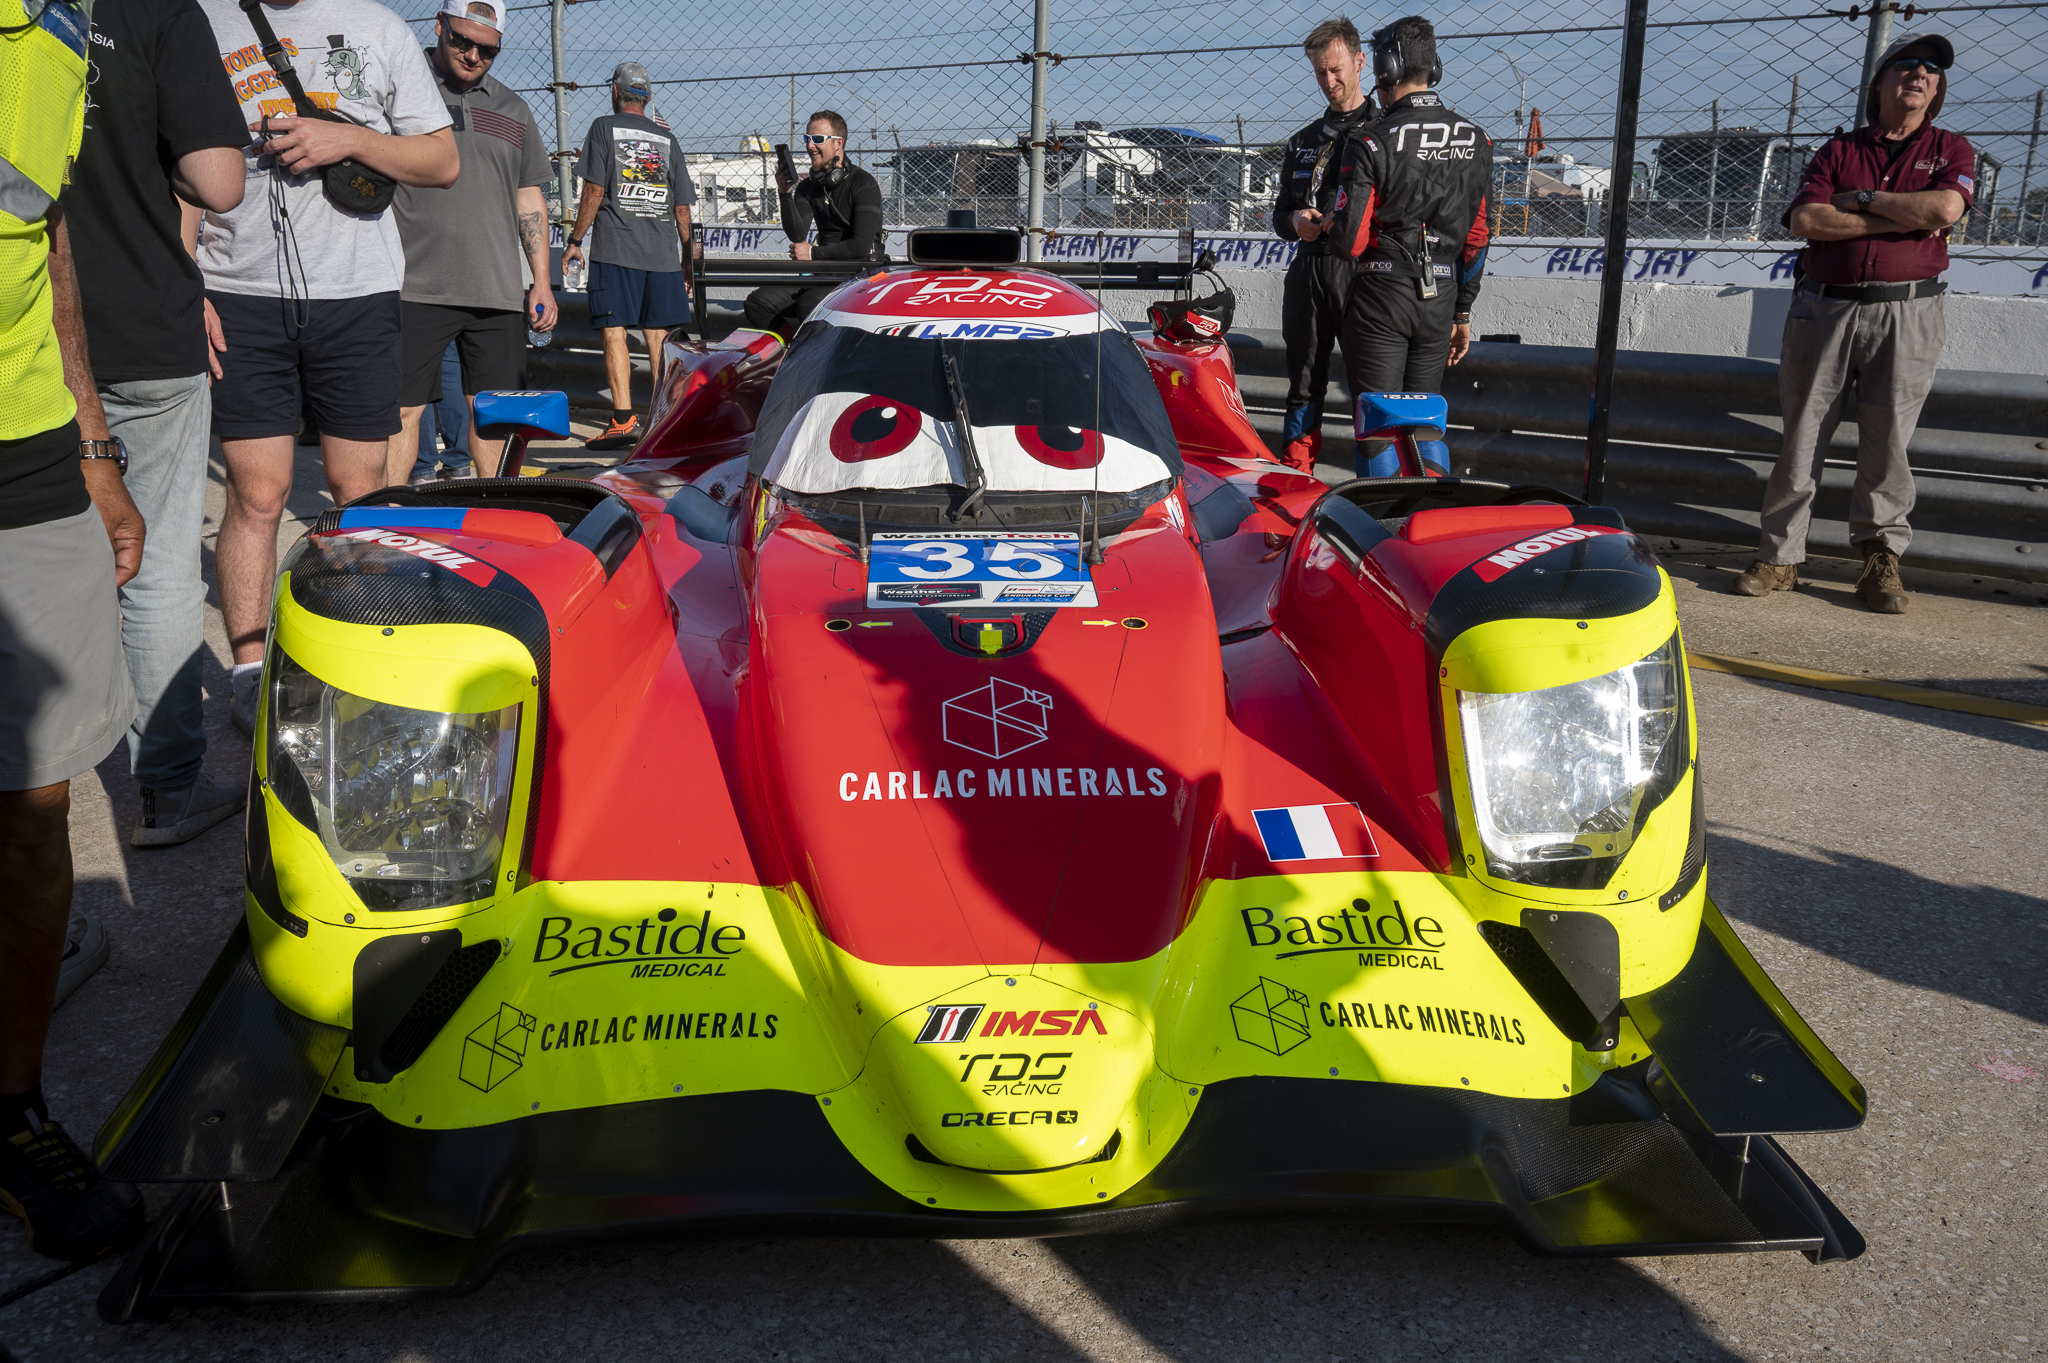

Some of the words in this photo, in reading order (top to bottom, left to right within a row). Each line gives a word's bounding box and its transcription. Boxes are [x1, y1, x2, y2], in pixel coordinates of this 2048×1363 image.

[1389, 121, 1476, 152] TDS
[1416, 147, 1476, 161] RACING
[635, 187, 665, 199] GTP
[1042, 236, 1100, 260] ALAN
[1101, 237, 1143, 262] JAY
[867, 276, 1062, 306] TDS
[904, 293, 1047, 310] RACING
[918, 323, 1055, 340] LMP2
[344, 528, 477, 570] MOTUL
[898, 541, 1064, 579] 35
[1487, 527, 1602, 569] MOTUL
[839, 769, 976, 802] CARLAC
[988, 767, 1167, 797] MINERALS
[533, 908, 746, 963] Bastide
[1241, 898, 1445, 947] Bastide
[630, 963, 727, 978] MEDICAL
[1358, 953, 1444, 971] MEDICAL
[540, 1015, 638, 1052] CARLAC
[643, 1012, 779, 1041] MINERALS
[979, 1010, 1108, 1037] IMSA
[1319, 1001, 1414, 1031] CARLAC
[1416, 1005, 1526, 1046] MINERALS
[958, 1052, 1073, 1083] TDS
[981, 1083, 1063, 1096] RACING
[941, 1110, 1053, 1128] ORECA
